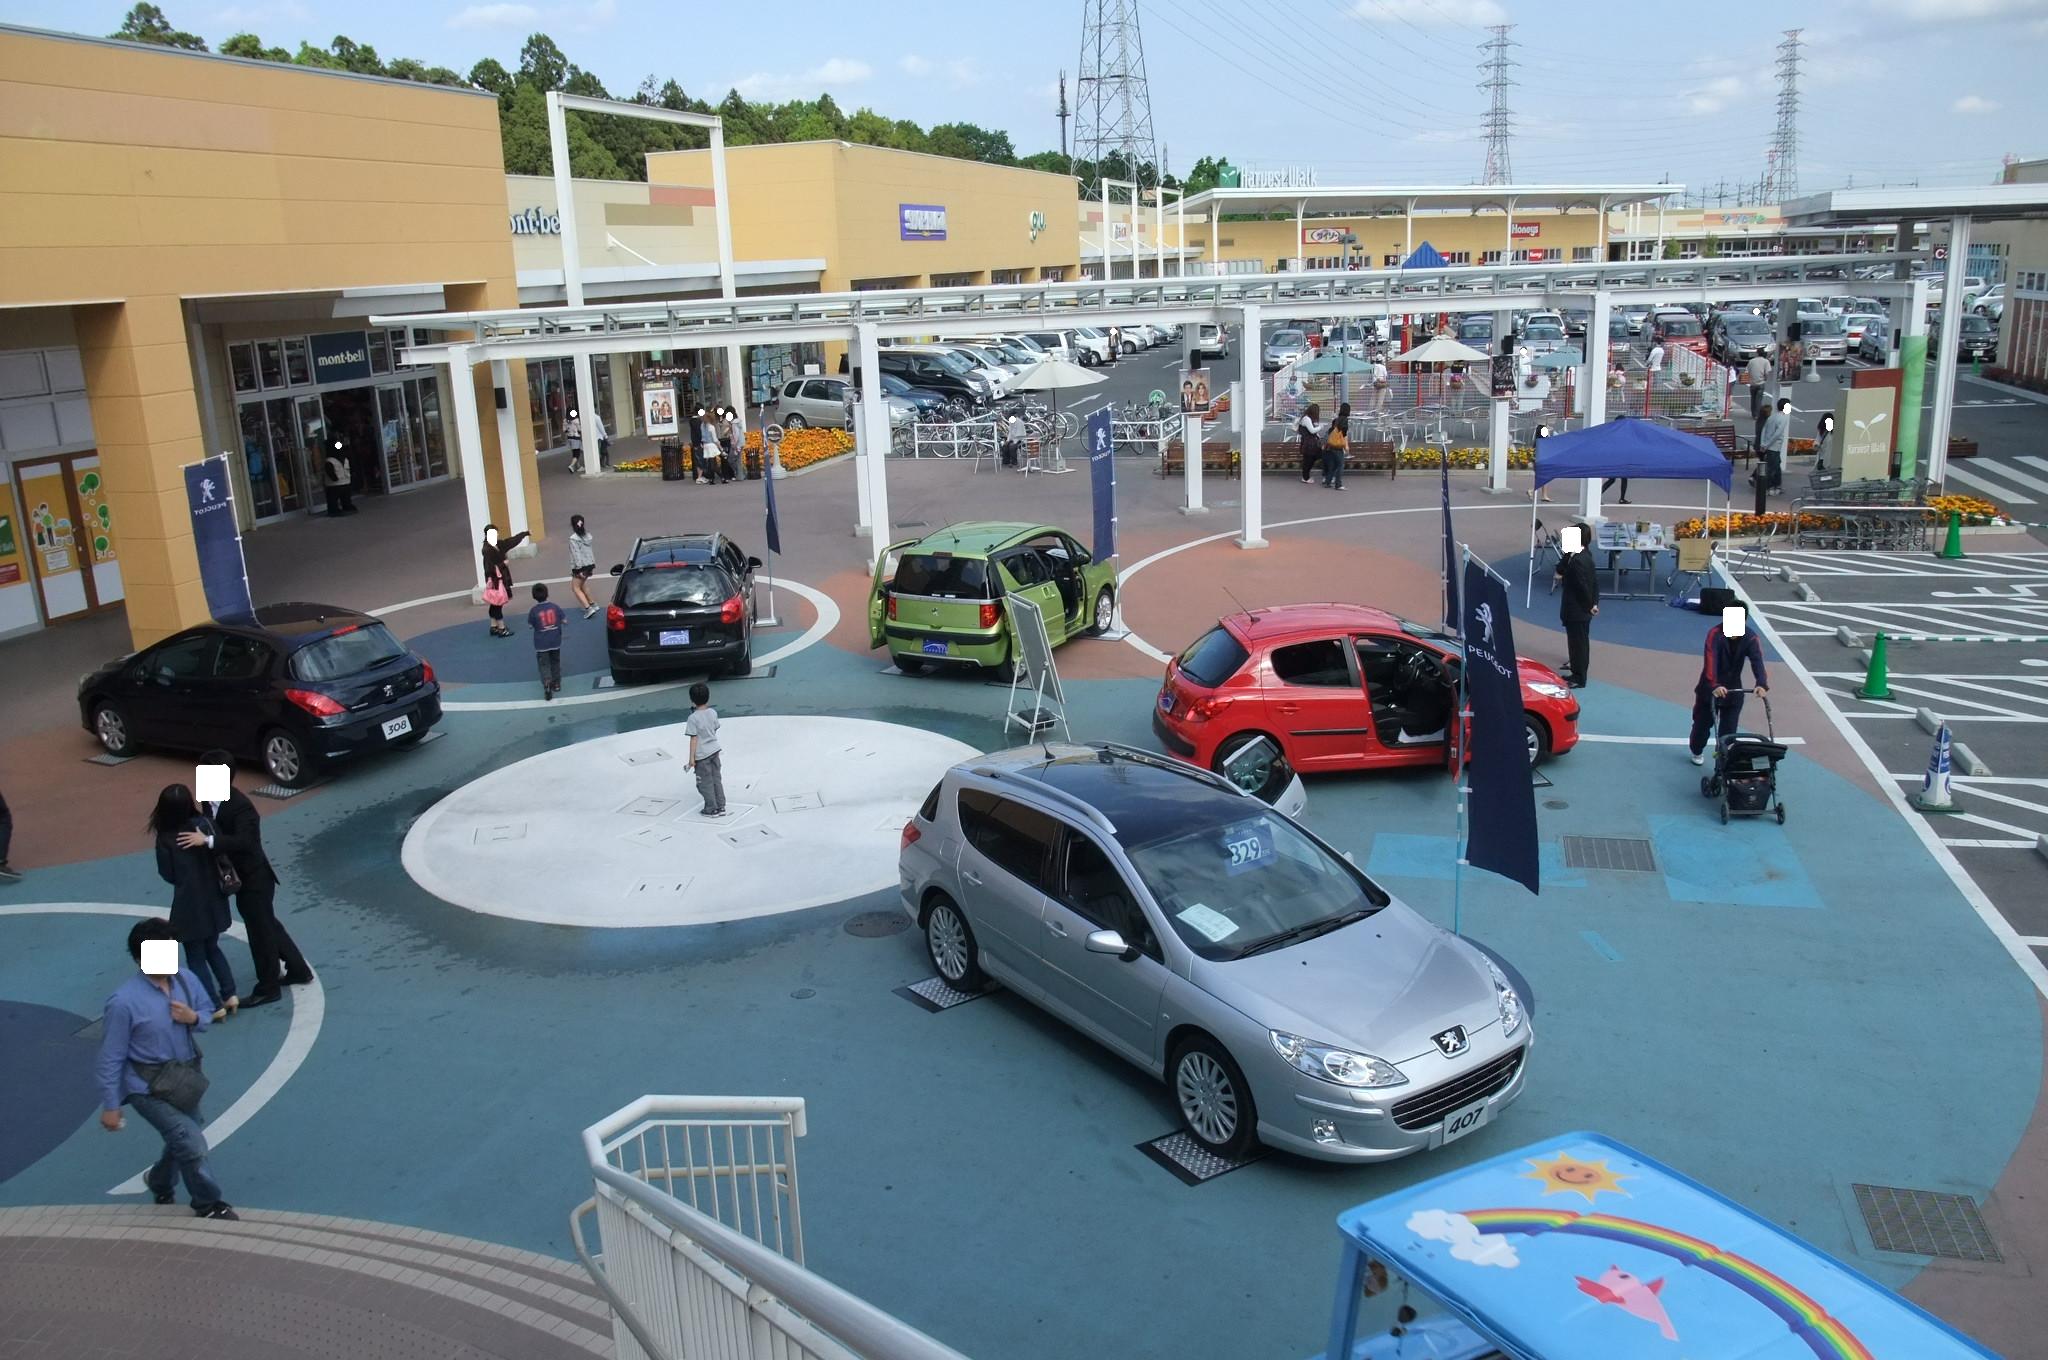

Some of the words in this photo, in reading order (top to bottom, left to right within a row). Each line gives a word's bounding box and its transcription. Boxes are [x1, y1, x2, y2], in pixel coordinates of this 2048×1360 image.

[387, 720, 407, 736] 308
[1230, 838, 1260, 864] 329
[1448, 1106, 1485, 1135] 407
